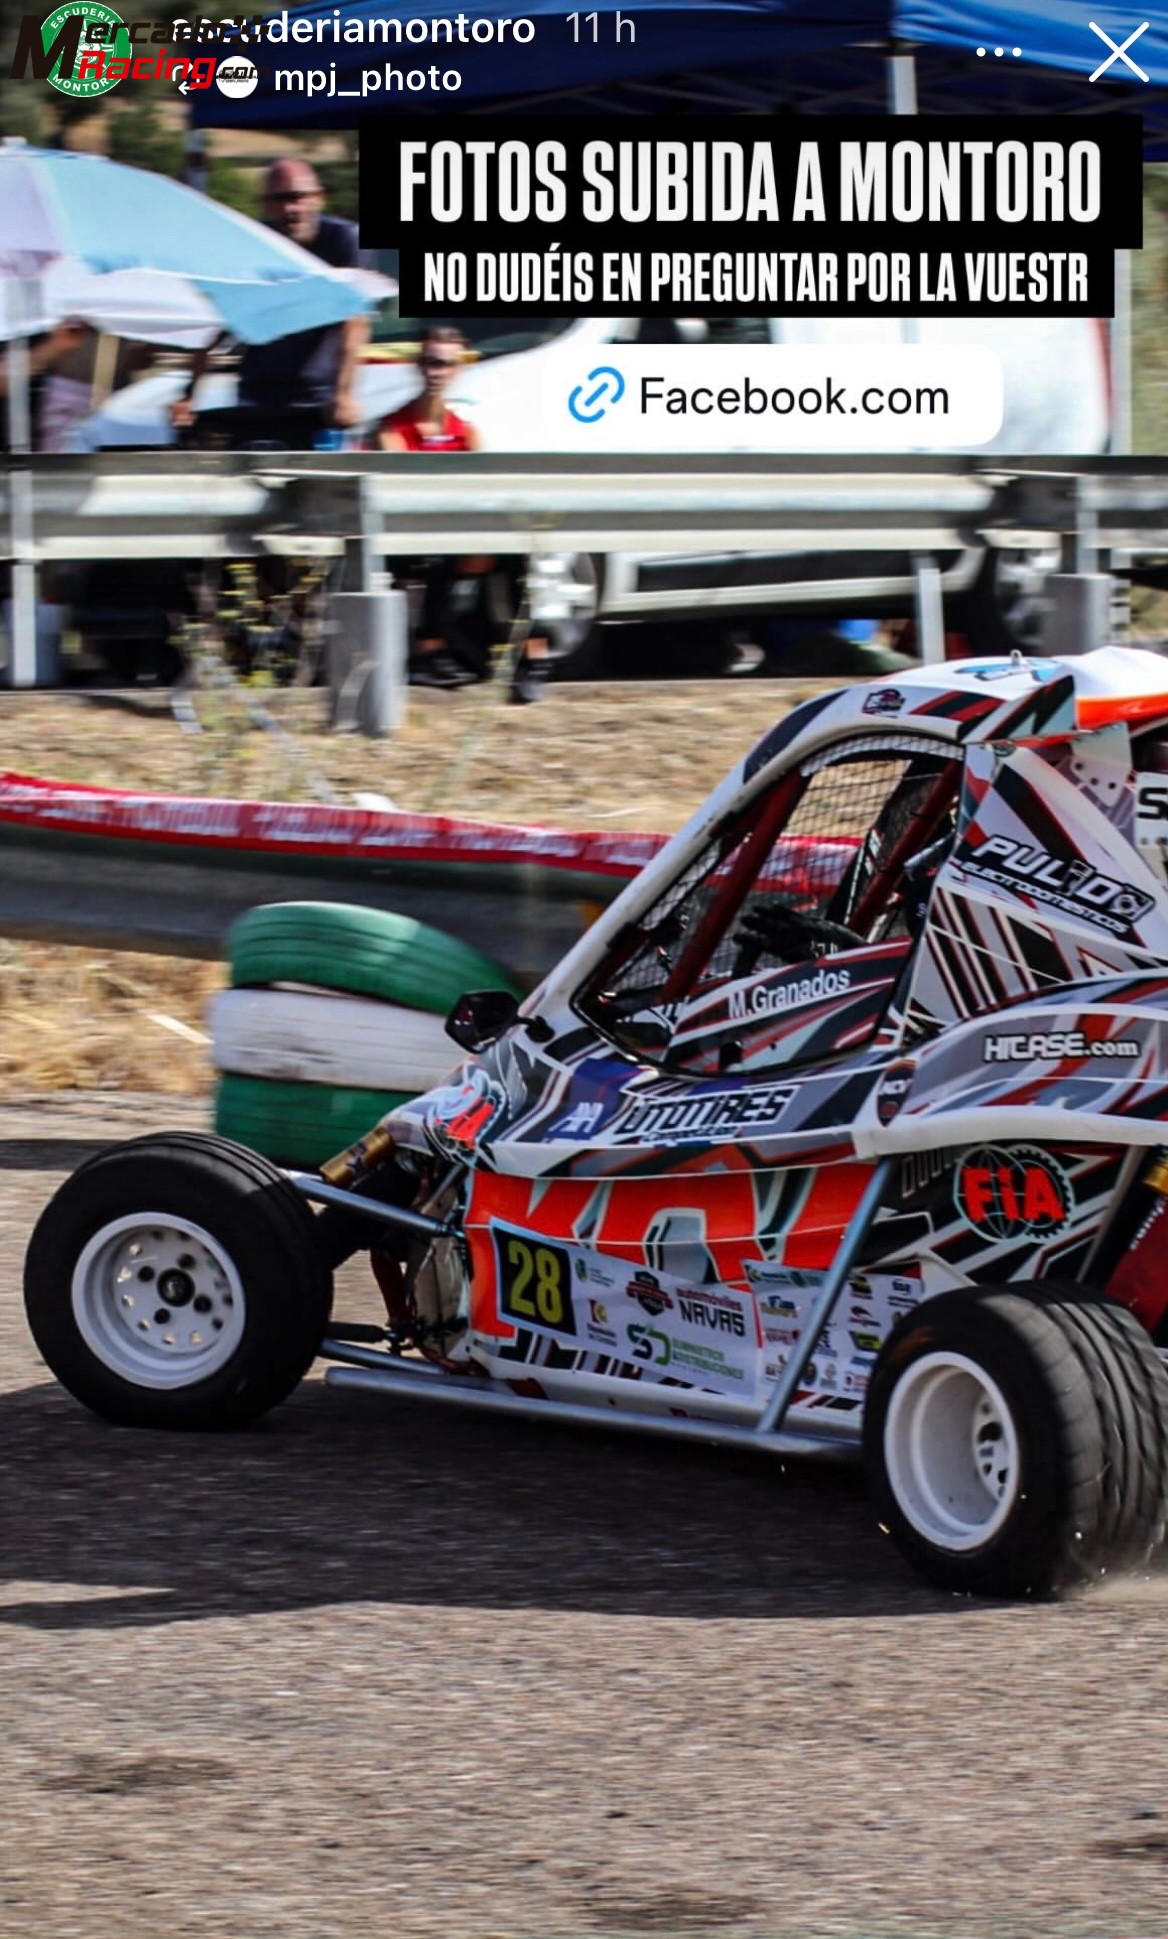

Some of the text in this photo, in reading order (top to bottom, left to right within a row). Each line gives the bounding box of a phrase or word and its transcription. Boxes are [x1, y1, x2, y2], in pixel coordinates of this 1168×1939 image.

[728, 969, 851, 1020] M.Granados
[508, 1240, 565, 1325] 28
[678, 1299, 746, 1338] NAVAS
